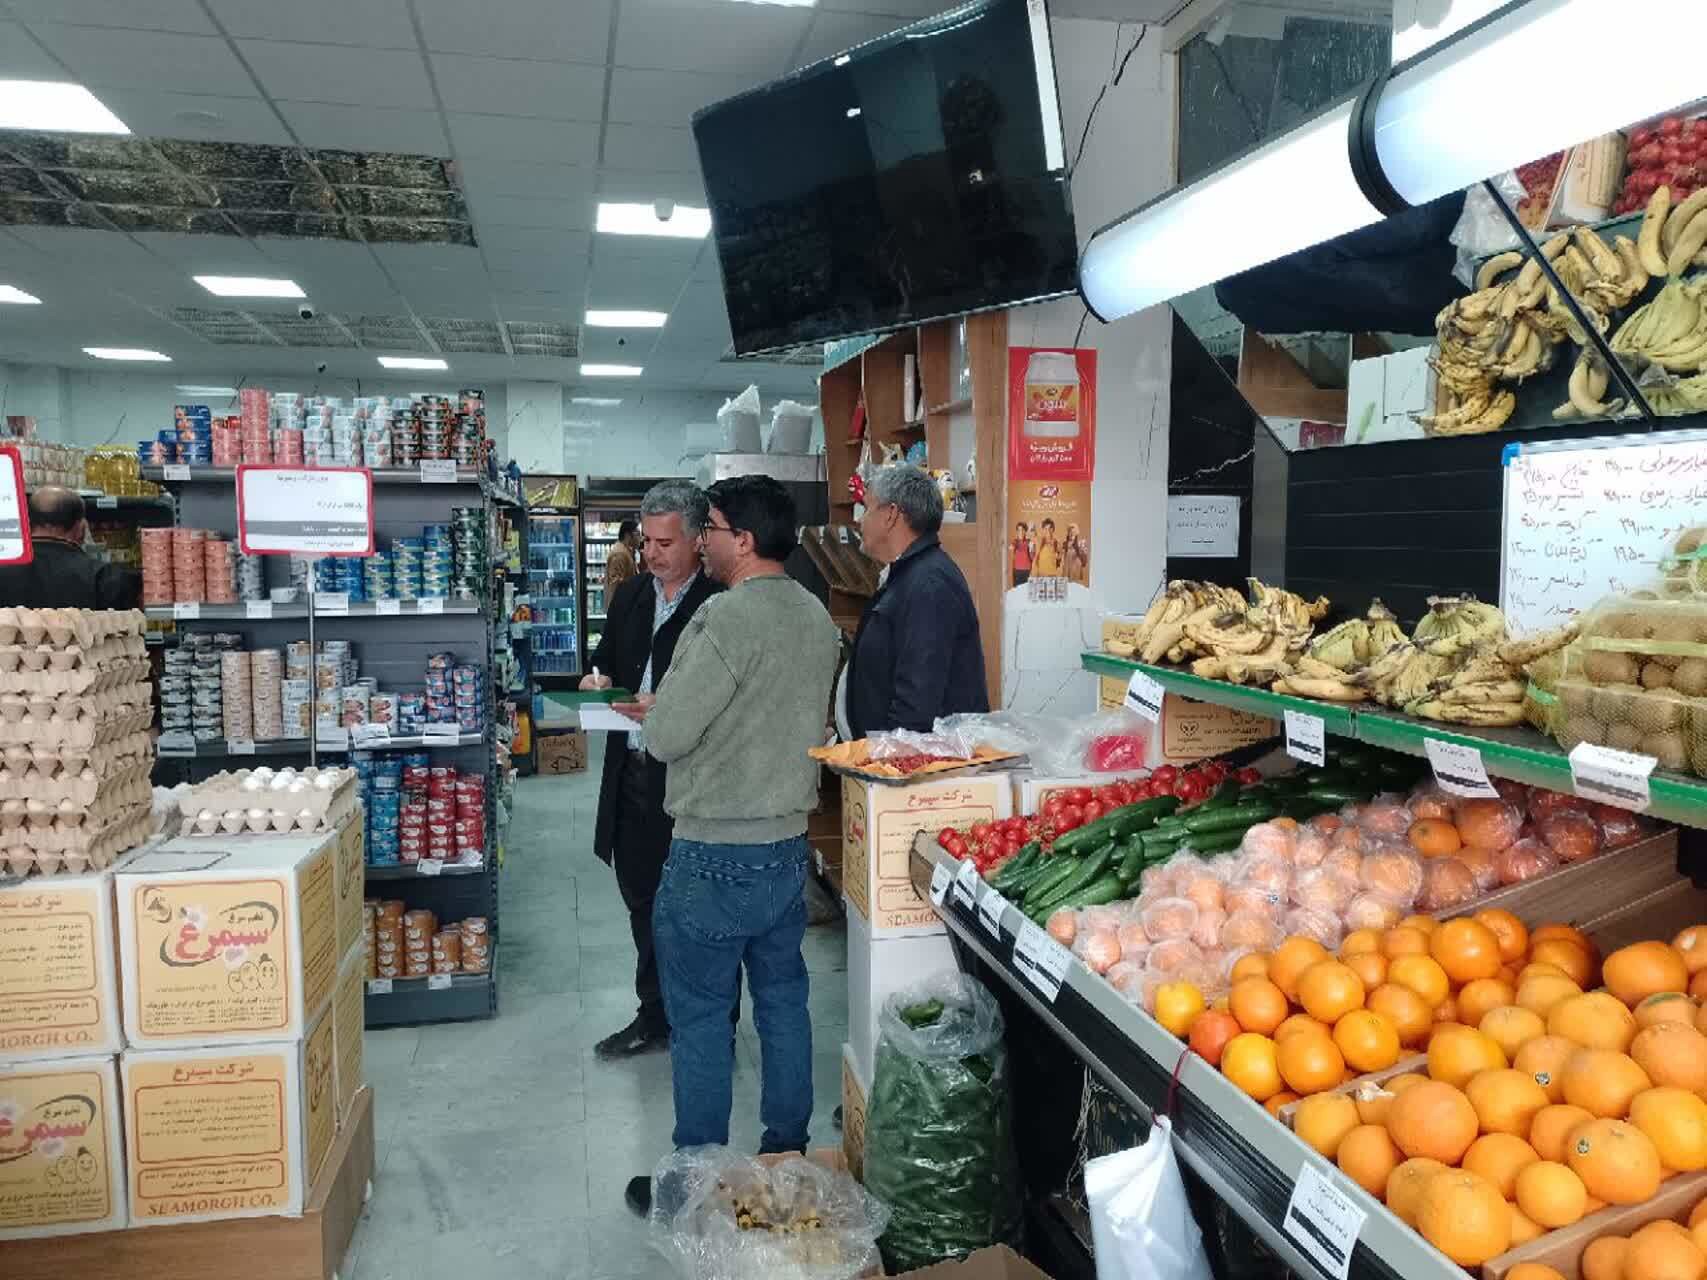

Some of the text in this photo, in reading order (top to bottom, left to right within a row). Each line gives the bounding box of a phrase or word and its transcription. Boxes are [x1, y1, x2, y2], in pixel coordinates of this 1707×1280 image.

[886, 911, 938, 927] SEAMO
[175, 923, 269, 960] سیمرغ
[147, 1193, 277, 1216] SEAMORGH CO.
